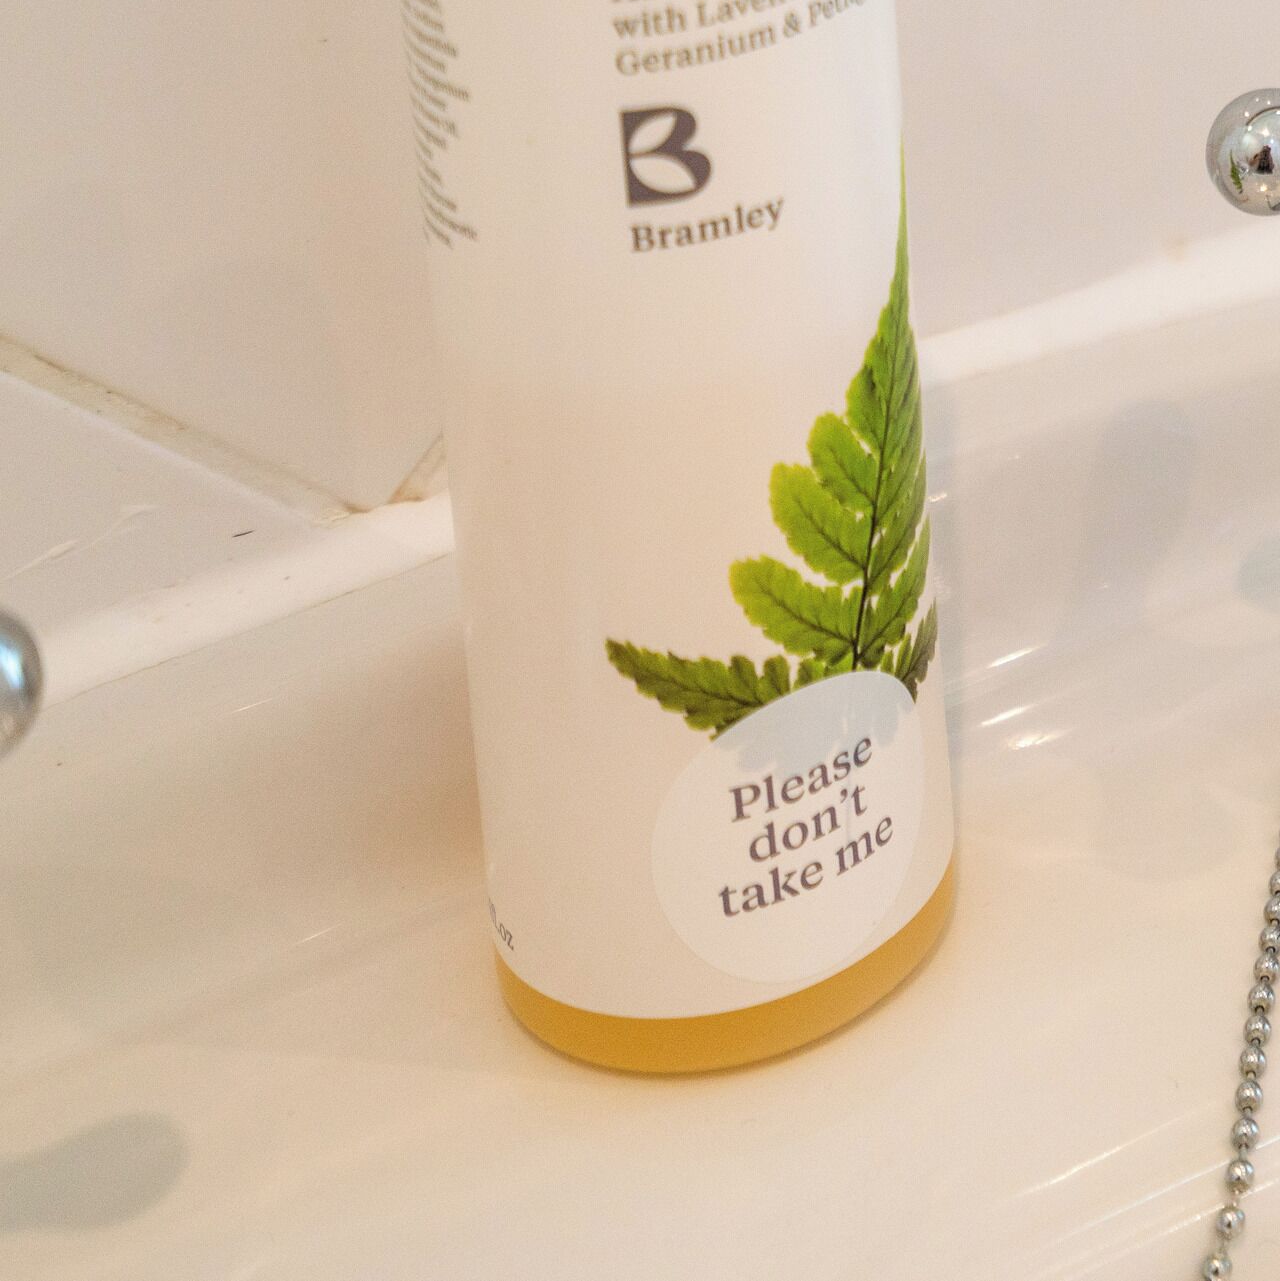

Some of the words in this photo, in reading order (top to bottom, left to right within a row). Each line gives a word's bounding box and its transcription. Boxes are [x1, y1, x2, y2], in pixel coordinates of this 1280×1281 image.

[613, 3, 688, 41] with
[614, 22, 777, 77] Geranium
[782, 11, 803, 39] &
[619, 104, 713, 208] B
[629, 196, 786, 255] Bramley
[728, 736, 874, 824] Please
[717, 860, 825, 919] take
[834, 815, 895, 877] me
